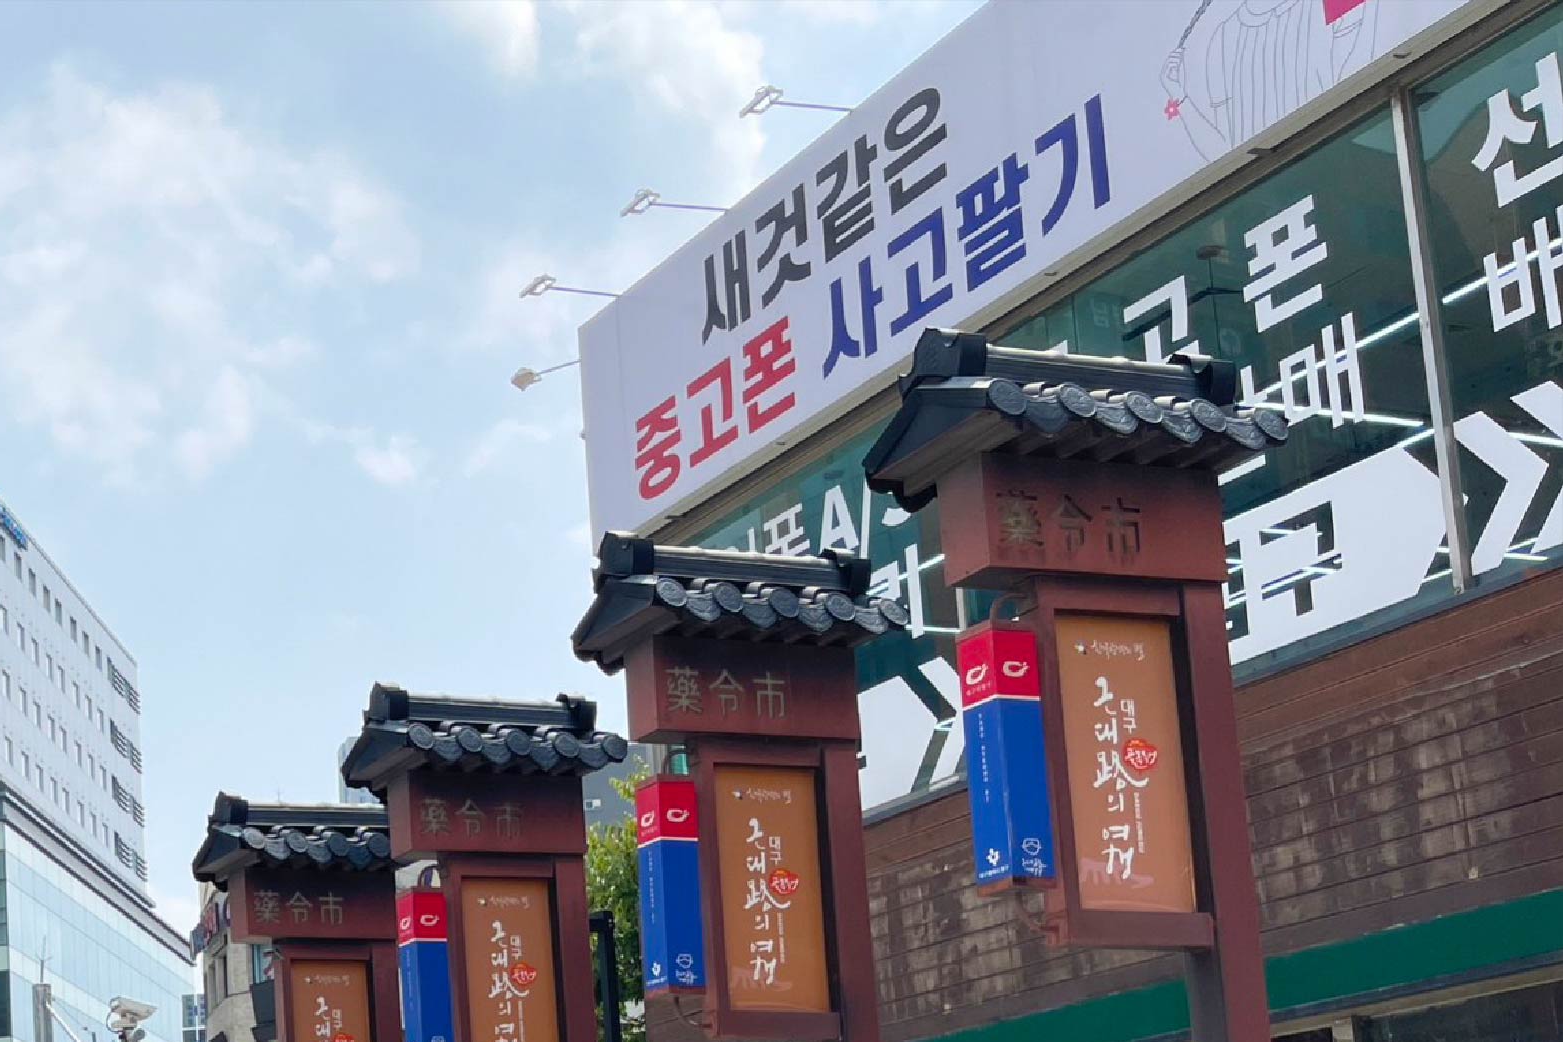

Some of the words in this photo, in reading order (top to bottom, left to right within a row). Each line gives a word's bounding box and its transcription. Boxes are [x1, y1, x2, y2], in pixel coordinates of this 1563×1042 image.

[700, 86, 949, 344] 새것같은
[634, 316, 797, 500] 중고폰
[822, 94, 1112, 378] 사고팔기
[1123, 194, 1327, 363] 고폰
[1240, 312, 1365, 430] 매
[665, 667, 788, 719] 藥令市
[1120, 700, 1136, 733] 대구
[768, 836, 782, 865] 대구
[253, 891, 344, 925] 藥令市
